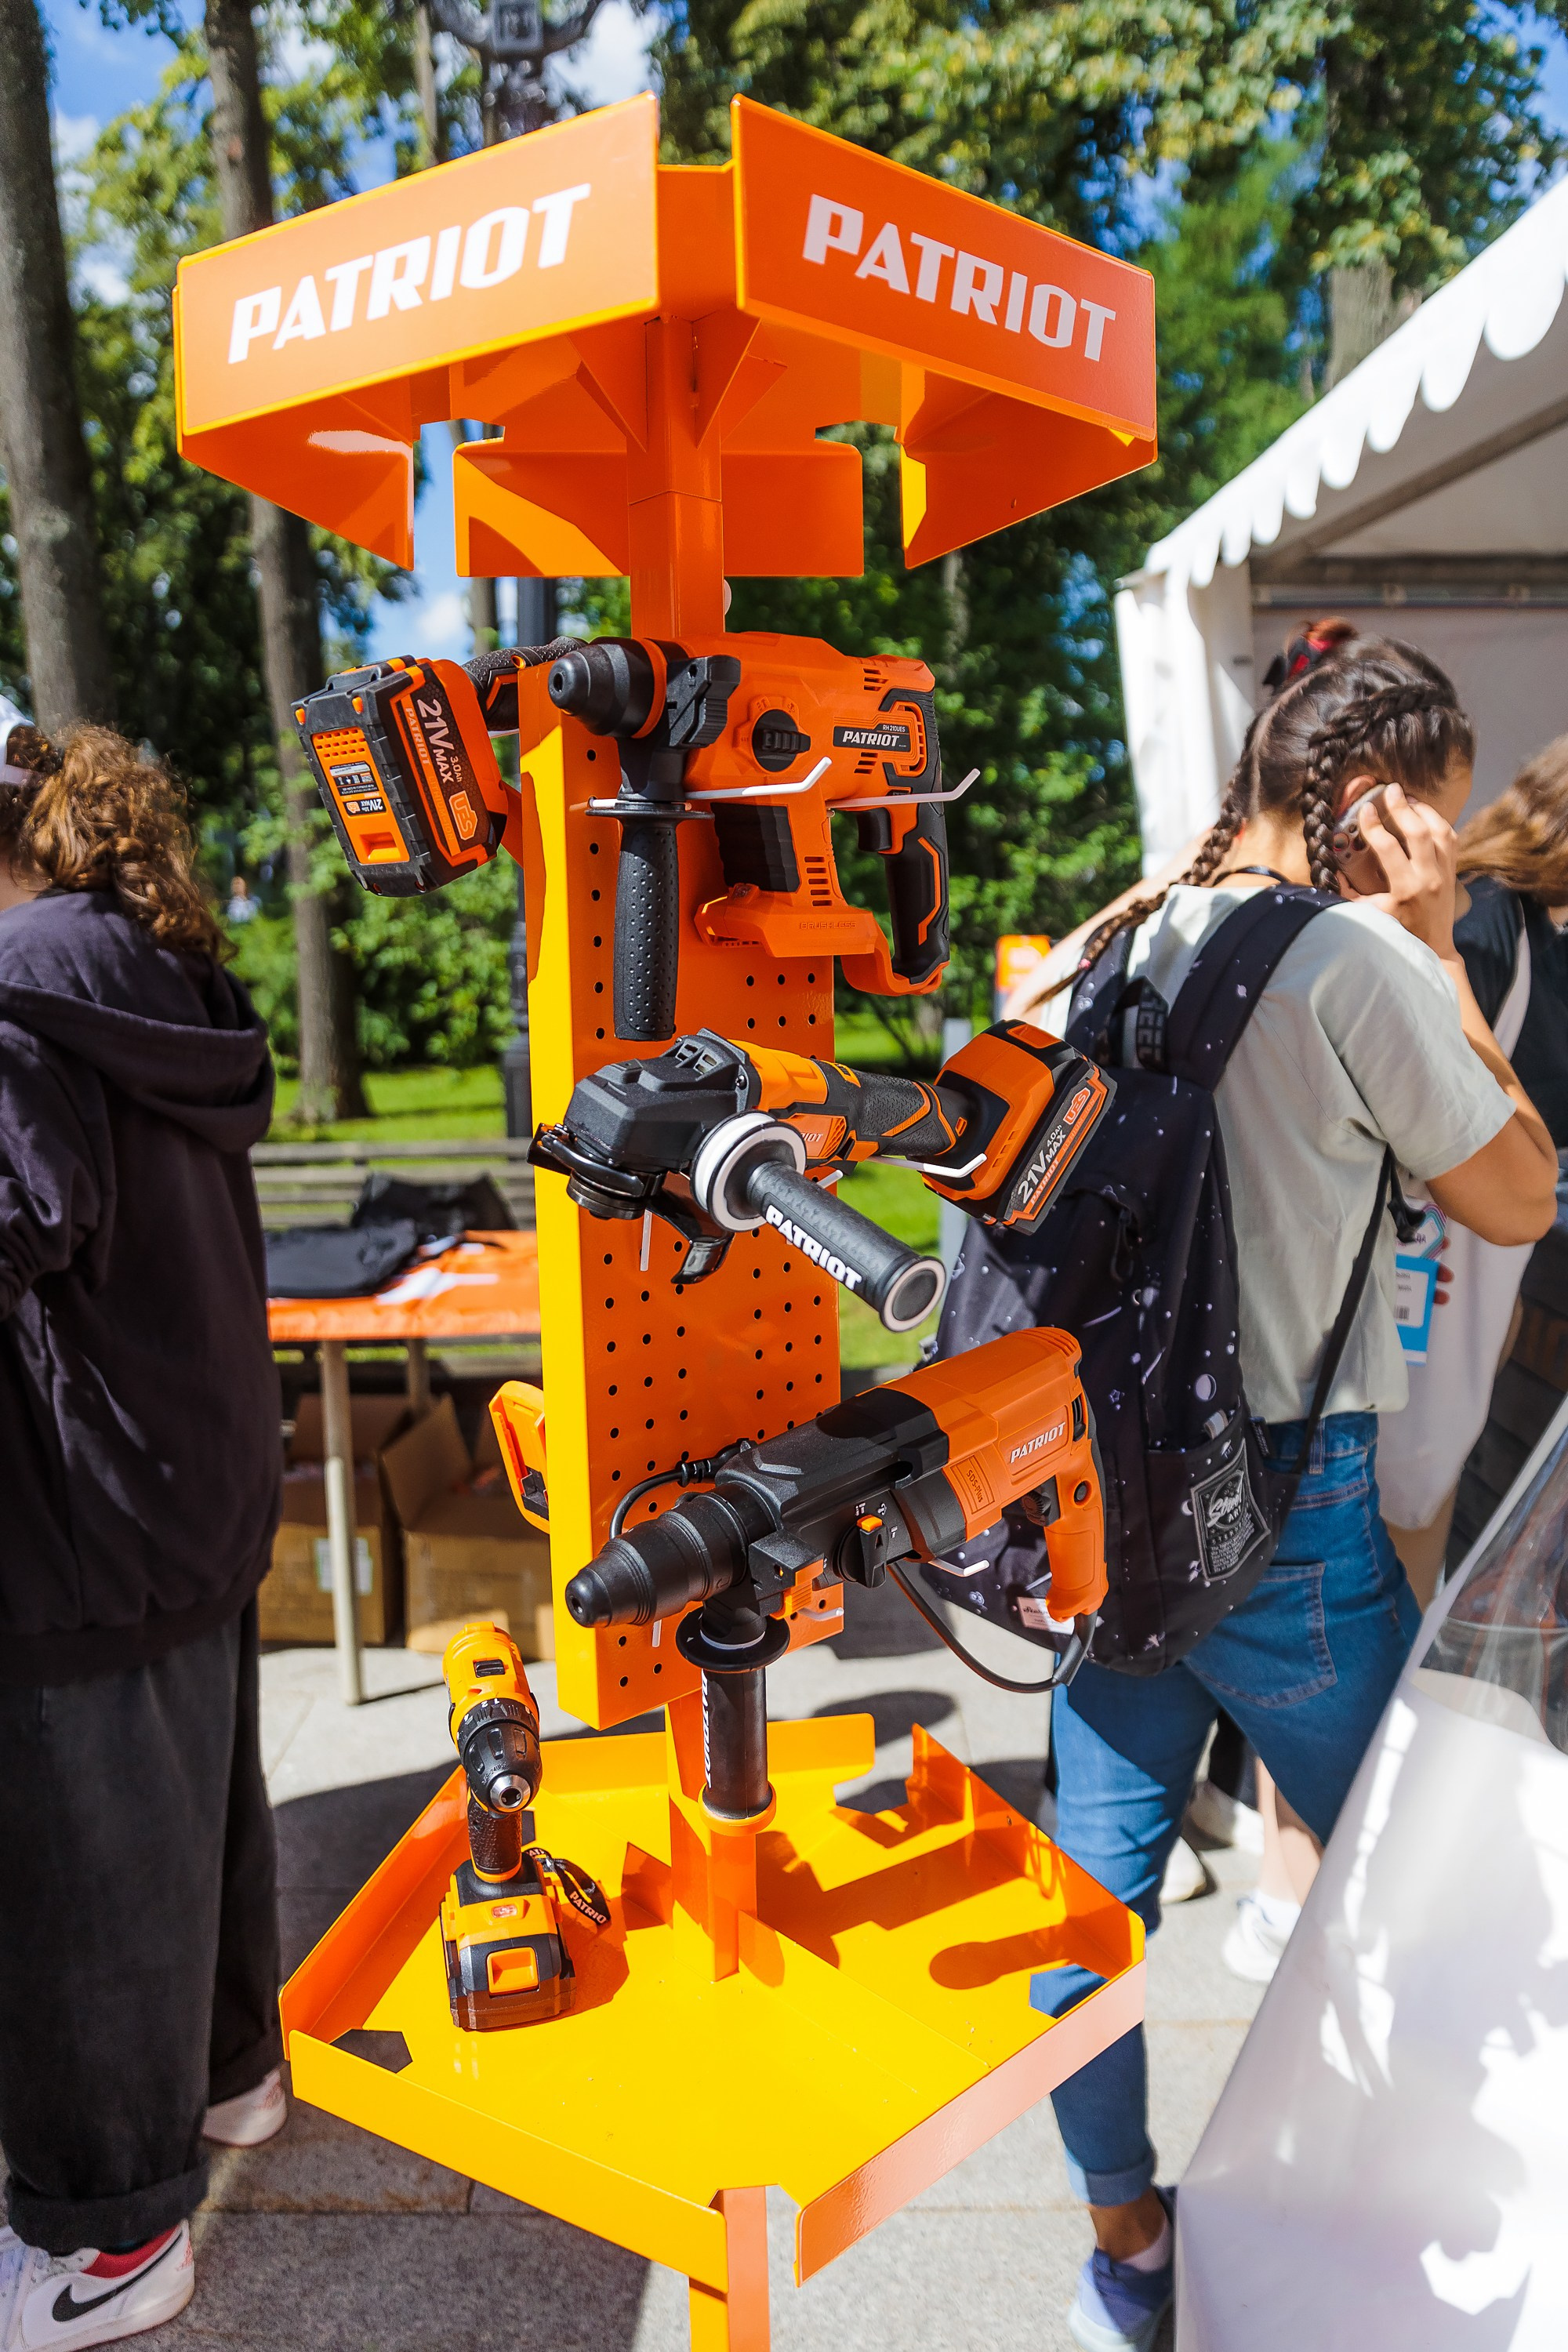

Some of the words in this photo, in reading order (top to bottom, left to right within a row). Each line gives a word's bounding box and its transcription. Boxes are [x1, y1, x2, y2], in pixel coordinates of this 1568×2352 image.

[227, 183, 591, 364] PATRIOT
[802, 194, 1116, 361] PATRIOT
[405, 707, 430, 765] PATRIOT
[417, 699, 455, 750] 21V
[843, 731, 899, 746] PATRIOT
[433, 749, 454, 784] MAX
[450, 756, 463, 782] 3.0Ah
[454, 797, 472, 833] UES
[800, 921, 857, 930] BRUSHLESS
[1067, 1092, 1087, 1121] UES
[1047, 1124, 1062, 1148] 4.0Ah
[1018, 1150, 1047, 1204] 21V
[1045, 1129, 1066, 1163] MAX
[1030, 1158, 1060, 1205] PATRIOT
[766, 1204, 862, 1290] PATRIOT
[1010, 1421, 1065, 1464] PATRIOT
